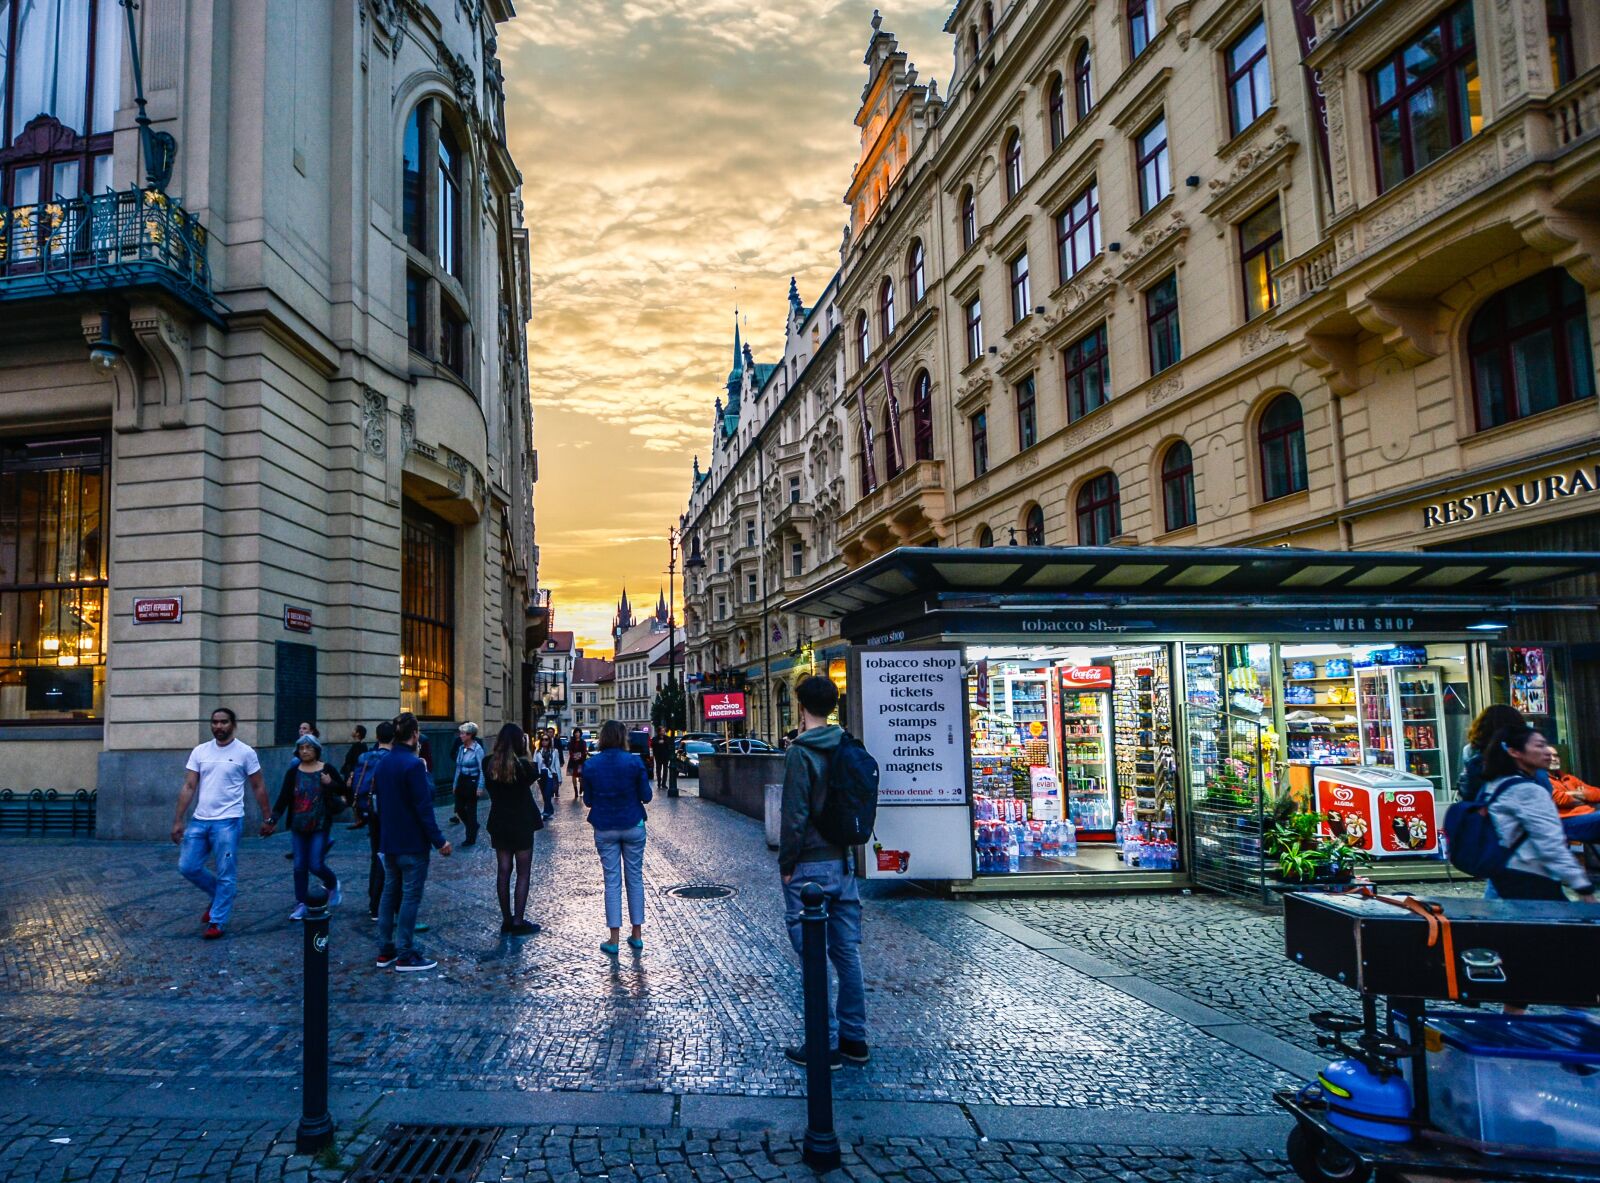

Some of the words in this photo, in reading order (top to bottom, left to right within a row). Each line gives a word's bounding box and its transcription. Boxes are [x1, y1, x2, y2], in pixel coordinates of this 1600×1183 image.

[1423, 465, 1600, 529] RESTAURA
[1022, 619, 1084, 631] tobacco
[1374, 618, 1414, 630] SHOP
[866, 658, 919, 668] tobacco
[922, 657, 956, 669] shop
[879, 672, 944, 684] cigarettes
[1072, 668, 1102, 680] Coca-Cola
[890, 687, 933, 697] tickets
[879, 701, 945, 714] postcards
[888, 718, 936, 728] stamps
[895, 733, 931, 743] maps
[892, 746, 934, 756] drinks
[886, 761, 943, 773] magnets
